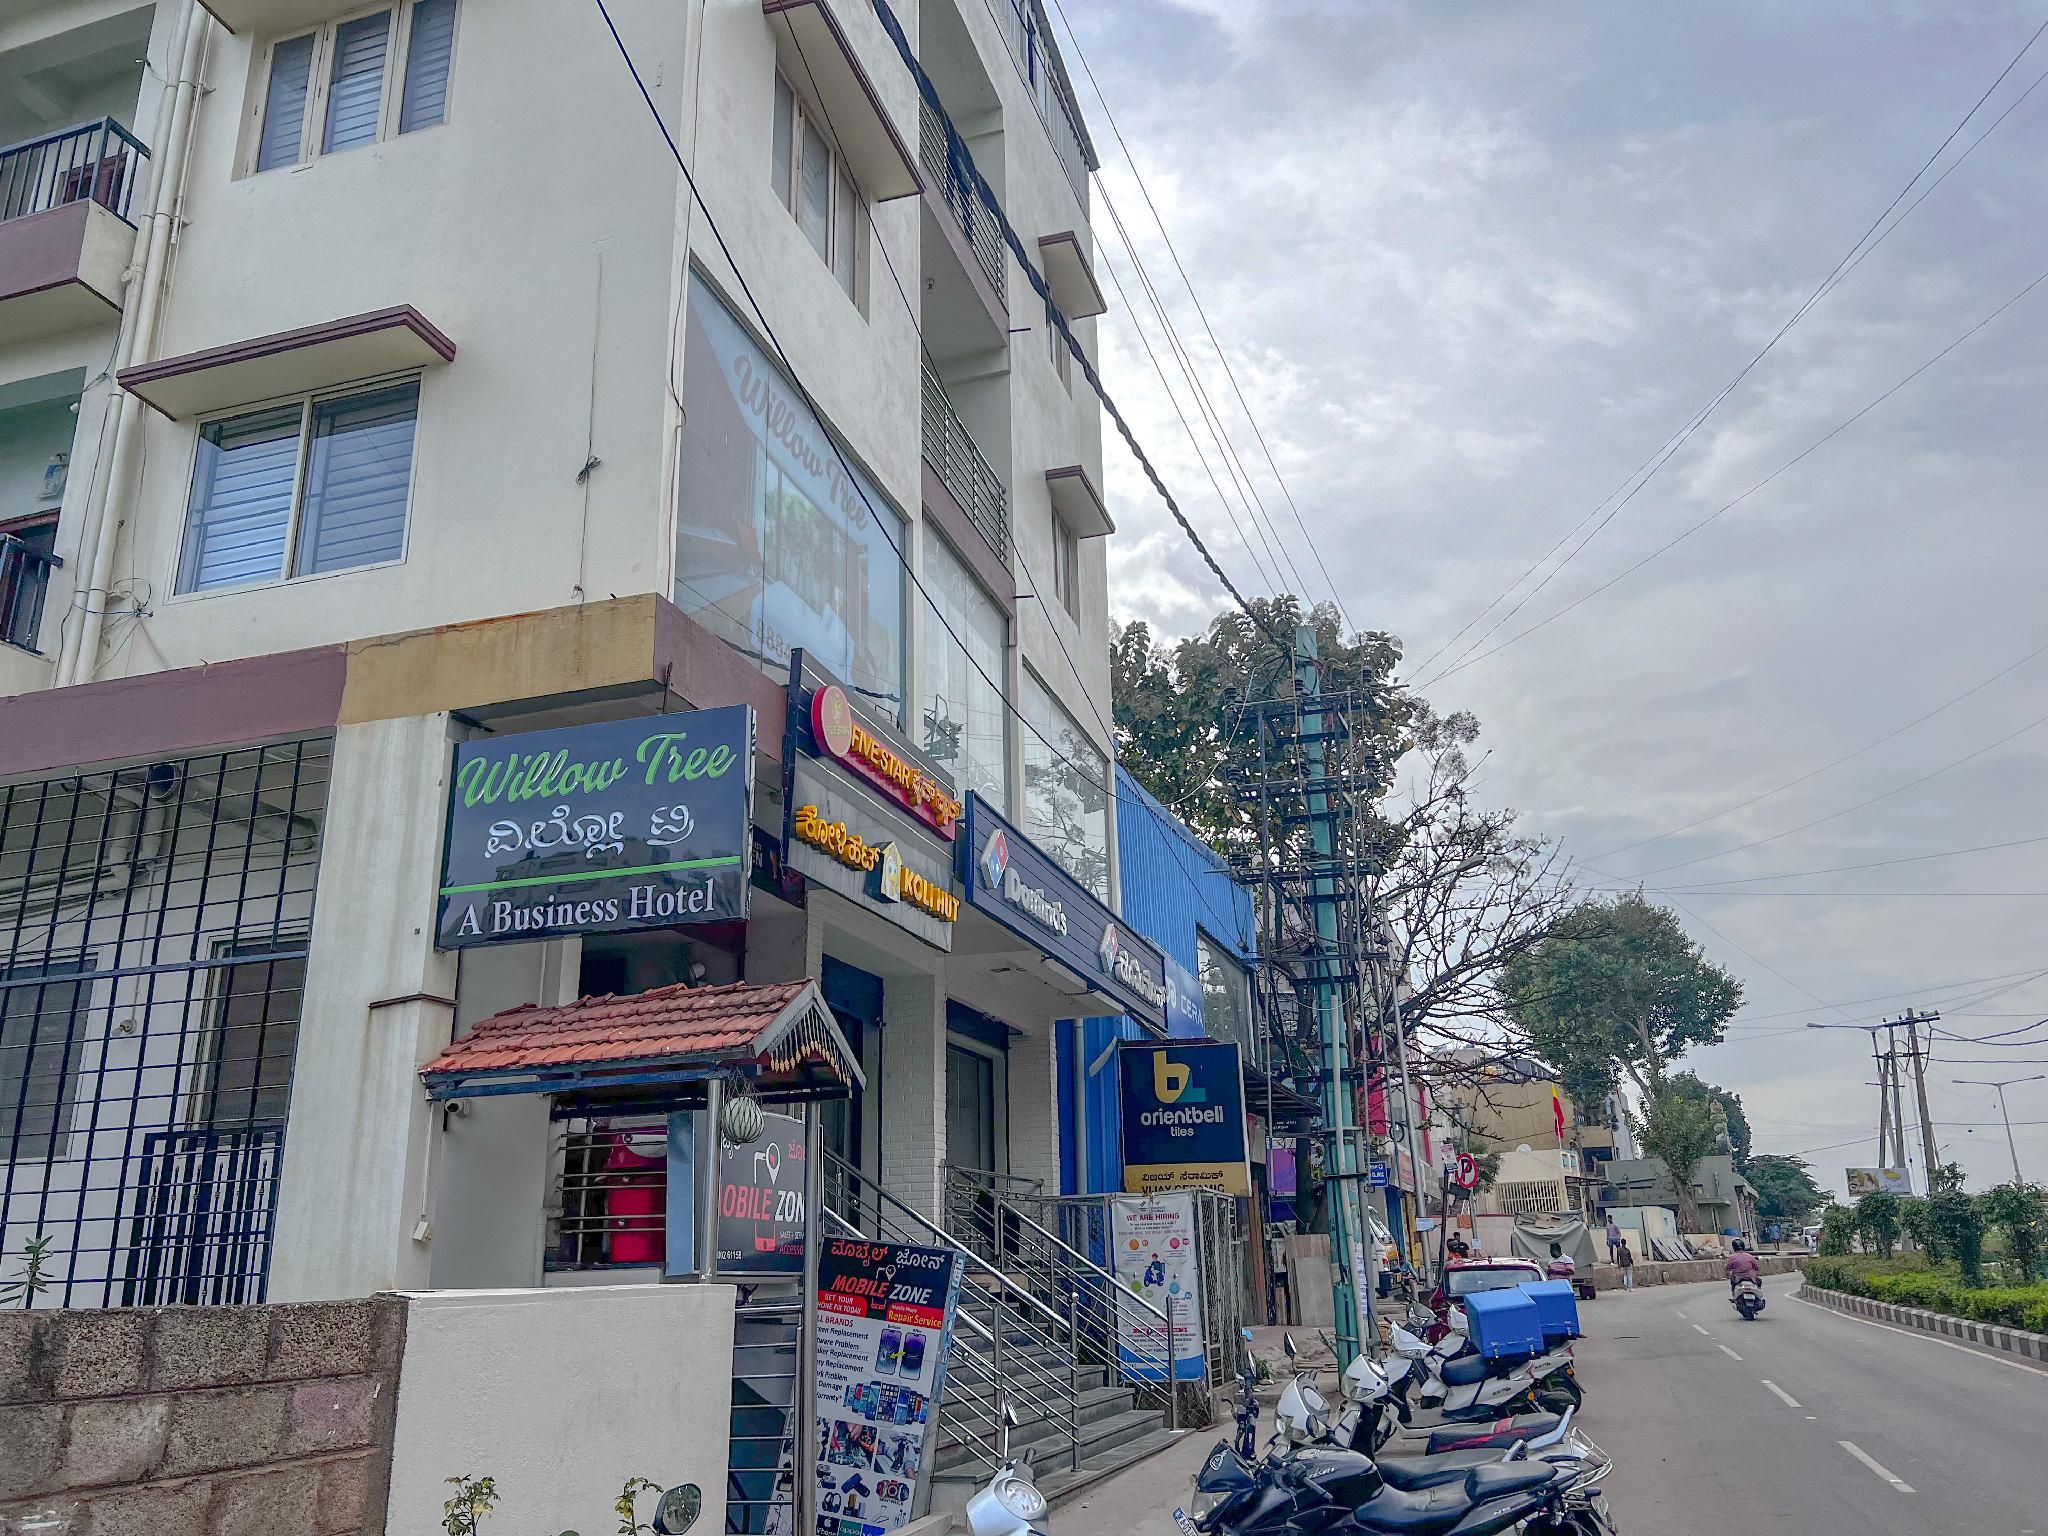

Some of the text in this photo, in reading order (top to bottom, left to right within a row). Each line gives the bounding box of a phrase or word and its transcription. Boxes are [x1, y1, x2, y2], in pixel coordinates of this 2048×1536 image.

[851, 724, 912, 789] FIVESTAR
[457, 732, 738, 808] Willow Tree
[901, 865, 960, 923] KOLI HUT
[456, 878, 715, 937] A Business Hotel
[1140, 1106, 1224, 1126] orientbell
[1170, 1126, 1195, 1137] tiles
[719, 1184, 805, 1223] OBILE ZON
[1126, 1212, 1180, 1222] WE ARE HIRING
[779, 1243, 804, 1255] ACCESSO
[831, 1275, 932, 1304] MOBILE ZONE
[825, 1293, 854, 1305] GET YOUR
[817, 1302, 832, 1311] HONE
[843, 1305, 862, 1315] TODAY
[825, 1315, 854, 1328] BRANDS
[888, 1310, 942, 1328] Repair Service
[829, 1327, 869, 1340] Replacement
[834, 1339, 860, 1351] Problem
[829, 1348, 869, 1362] Replacement
[825, 1359, 864, 1373] Replacement
[824, 1371, 848, 1382] Problem
[818, 1381, 843, 1391] Damage
